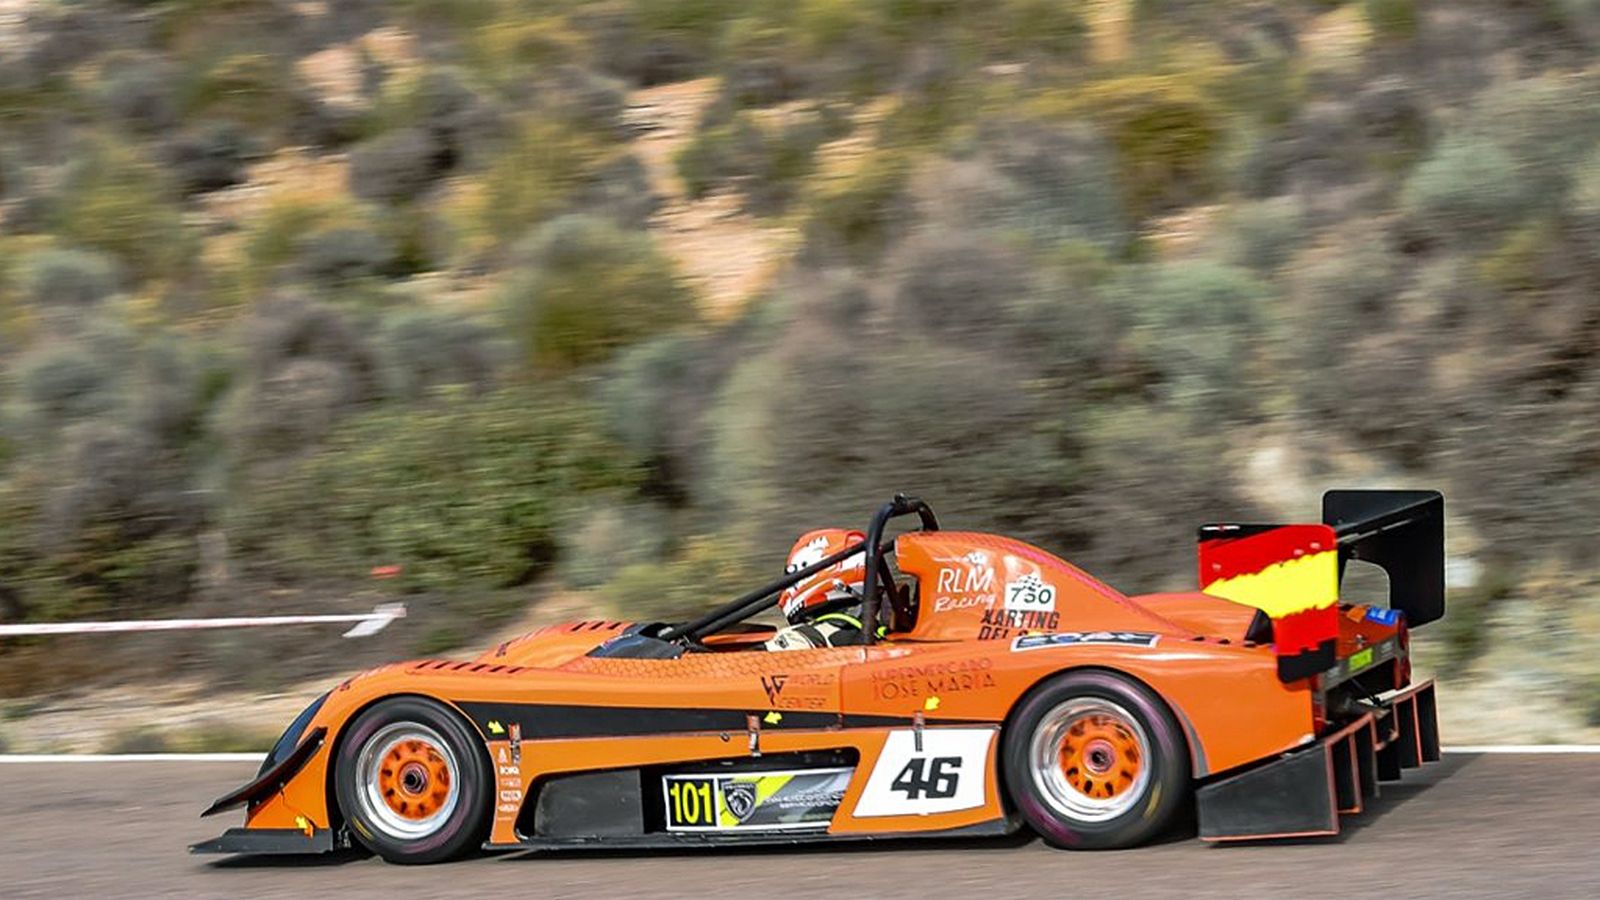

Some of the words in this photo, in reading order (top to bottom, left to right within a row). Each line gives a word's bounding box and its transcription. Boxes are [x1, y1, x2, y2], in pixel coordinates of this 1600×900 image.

[937, 565, 994, 593] RLM
[890, 756, 963, 800] 46
[669, 781, 713, 824] 101
